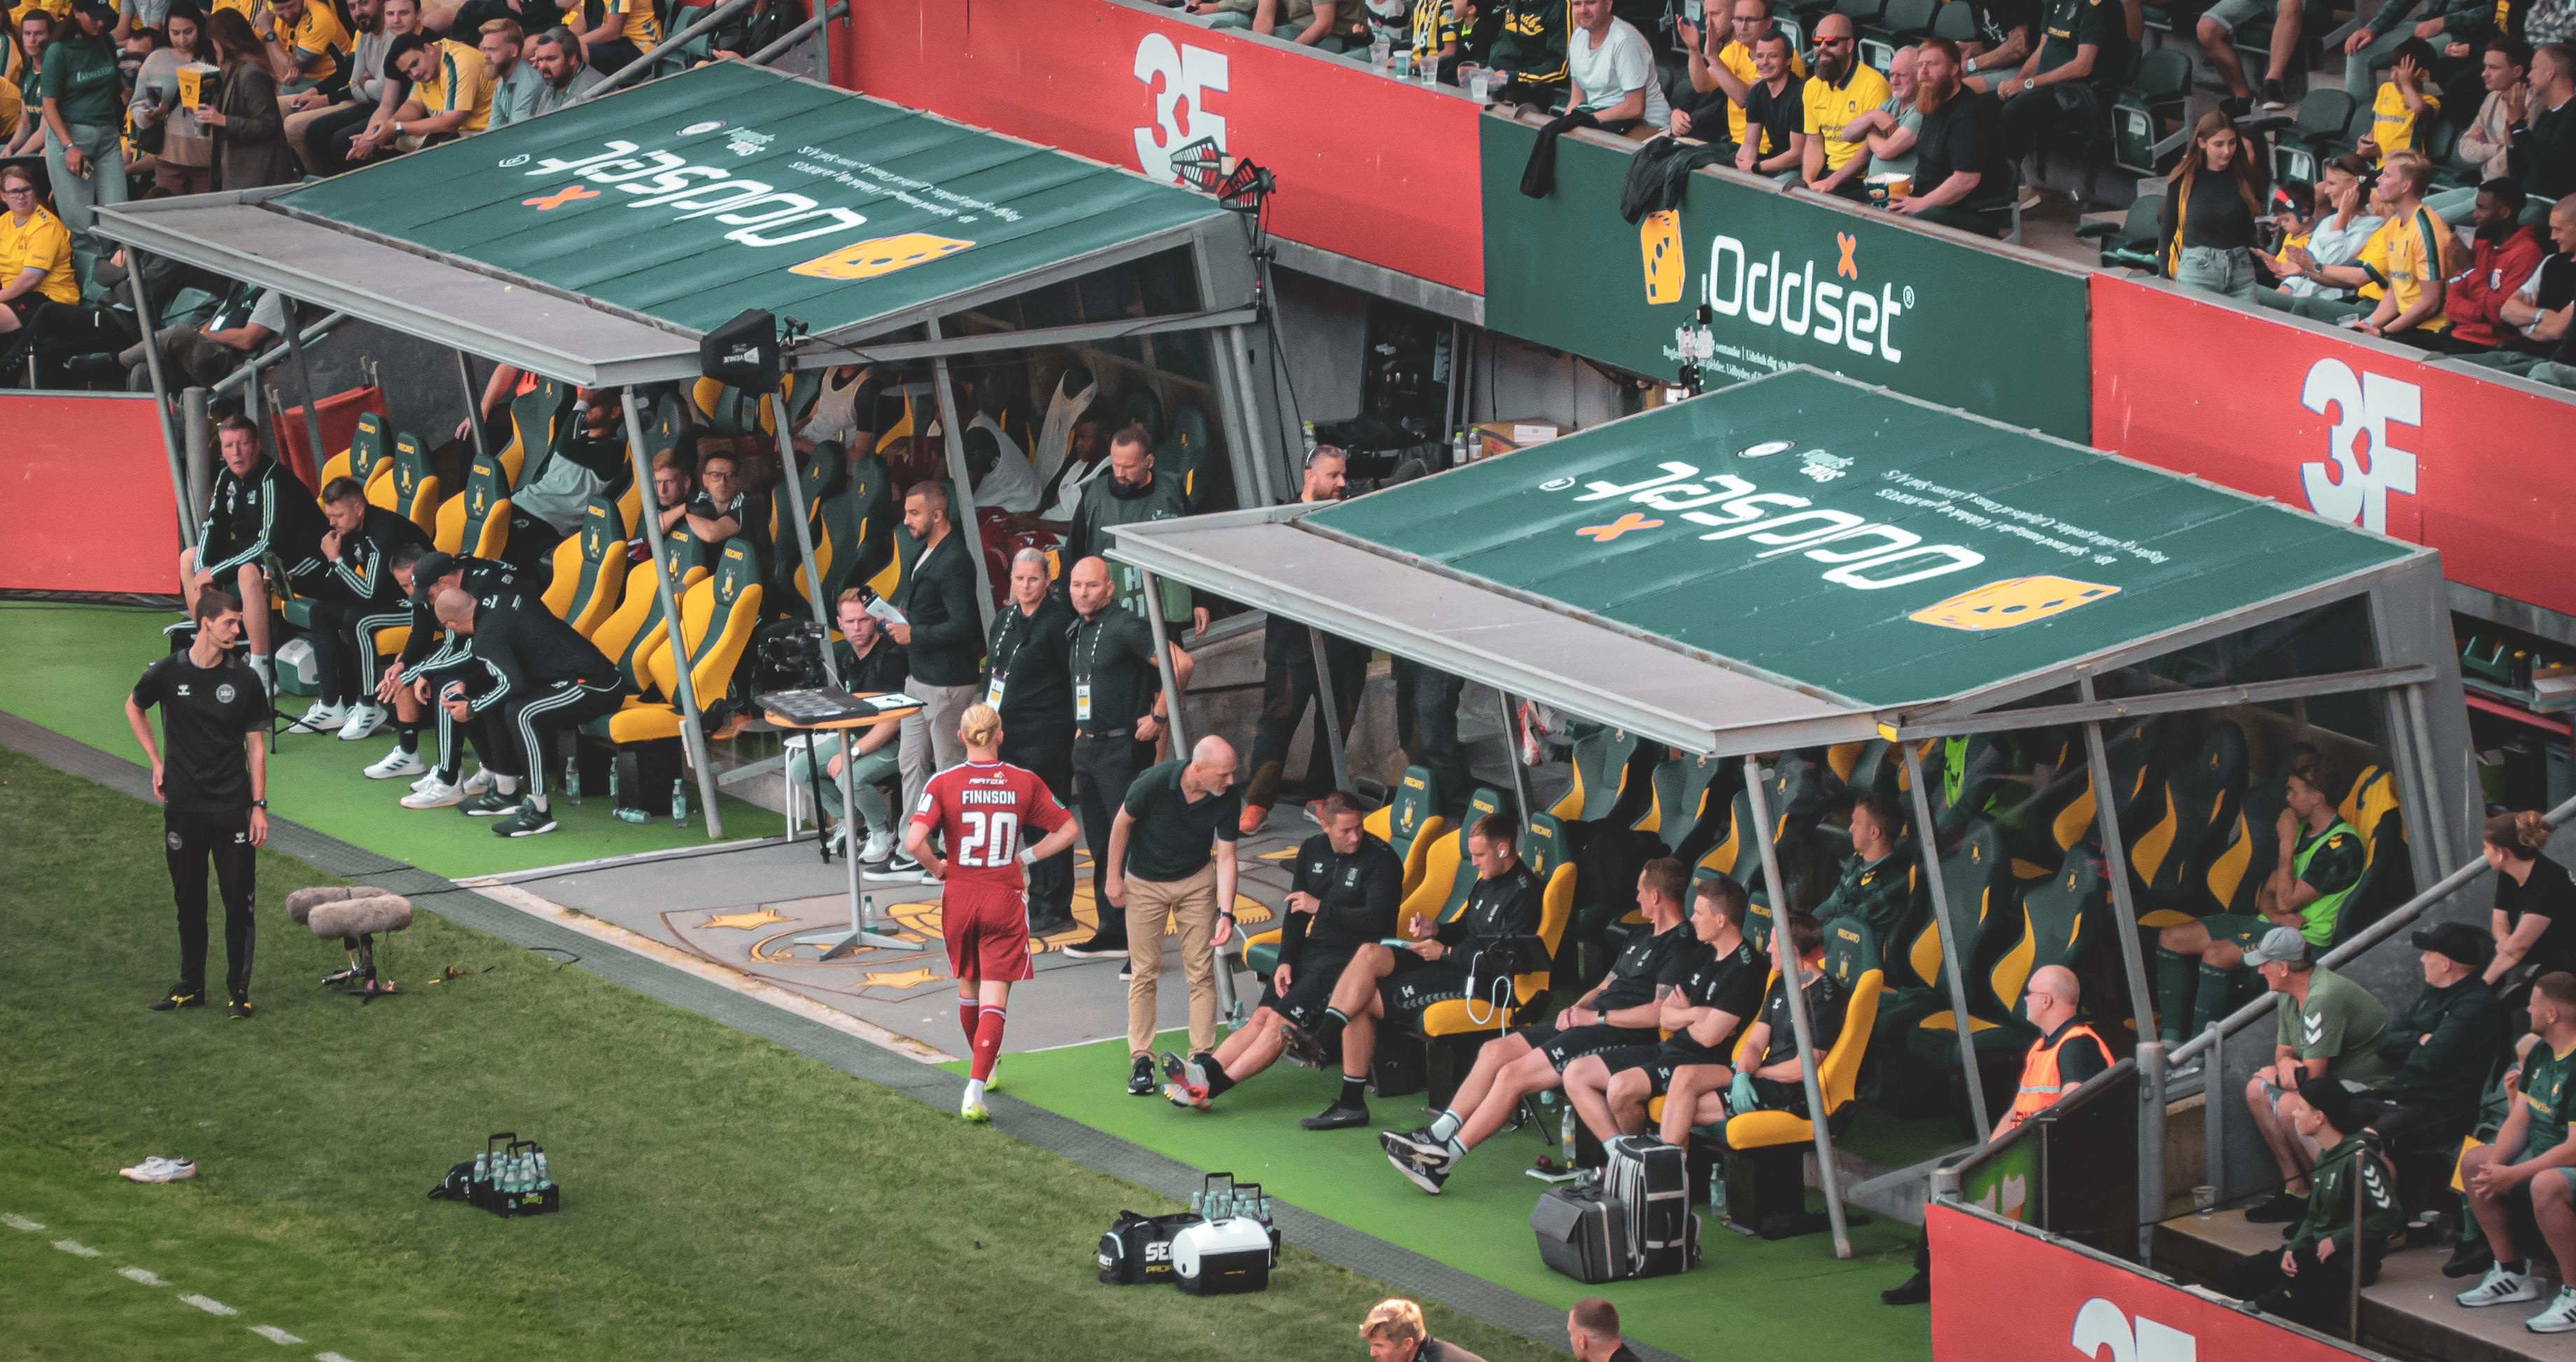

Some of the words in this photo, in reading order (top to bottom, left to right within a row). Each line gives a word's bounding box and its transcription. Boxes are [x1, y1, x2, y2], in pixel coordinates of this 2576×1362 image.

[1133, 32, 1229, 190] 3F
[524, 139, 867, 248] Oddset
[1709, 235, 1903, 364] Oddset
[2300, 358, 2422, 535] 3F
[588, 505, 605, 518] RECARO
[1573, 461, 1986, 590] Oddset
[724, 548, 743, 561] RECARO
[1404, 777, 1424, 790] RECARO
[962, 790, 1016, 805] FINNSON
[1473, 800, 1494, 813] RECARO
[1531, 824, 1552, 838] RECARO
[958, 812, 1018, 868] 20
[1837, 928, 1860, 943] RECARO
